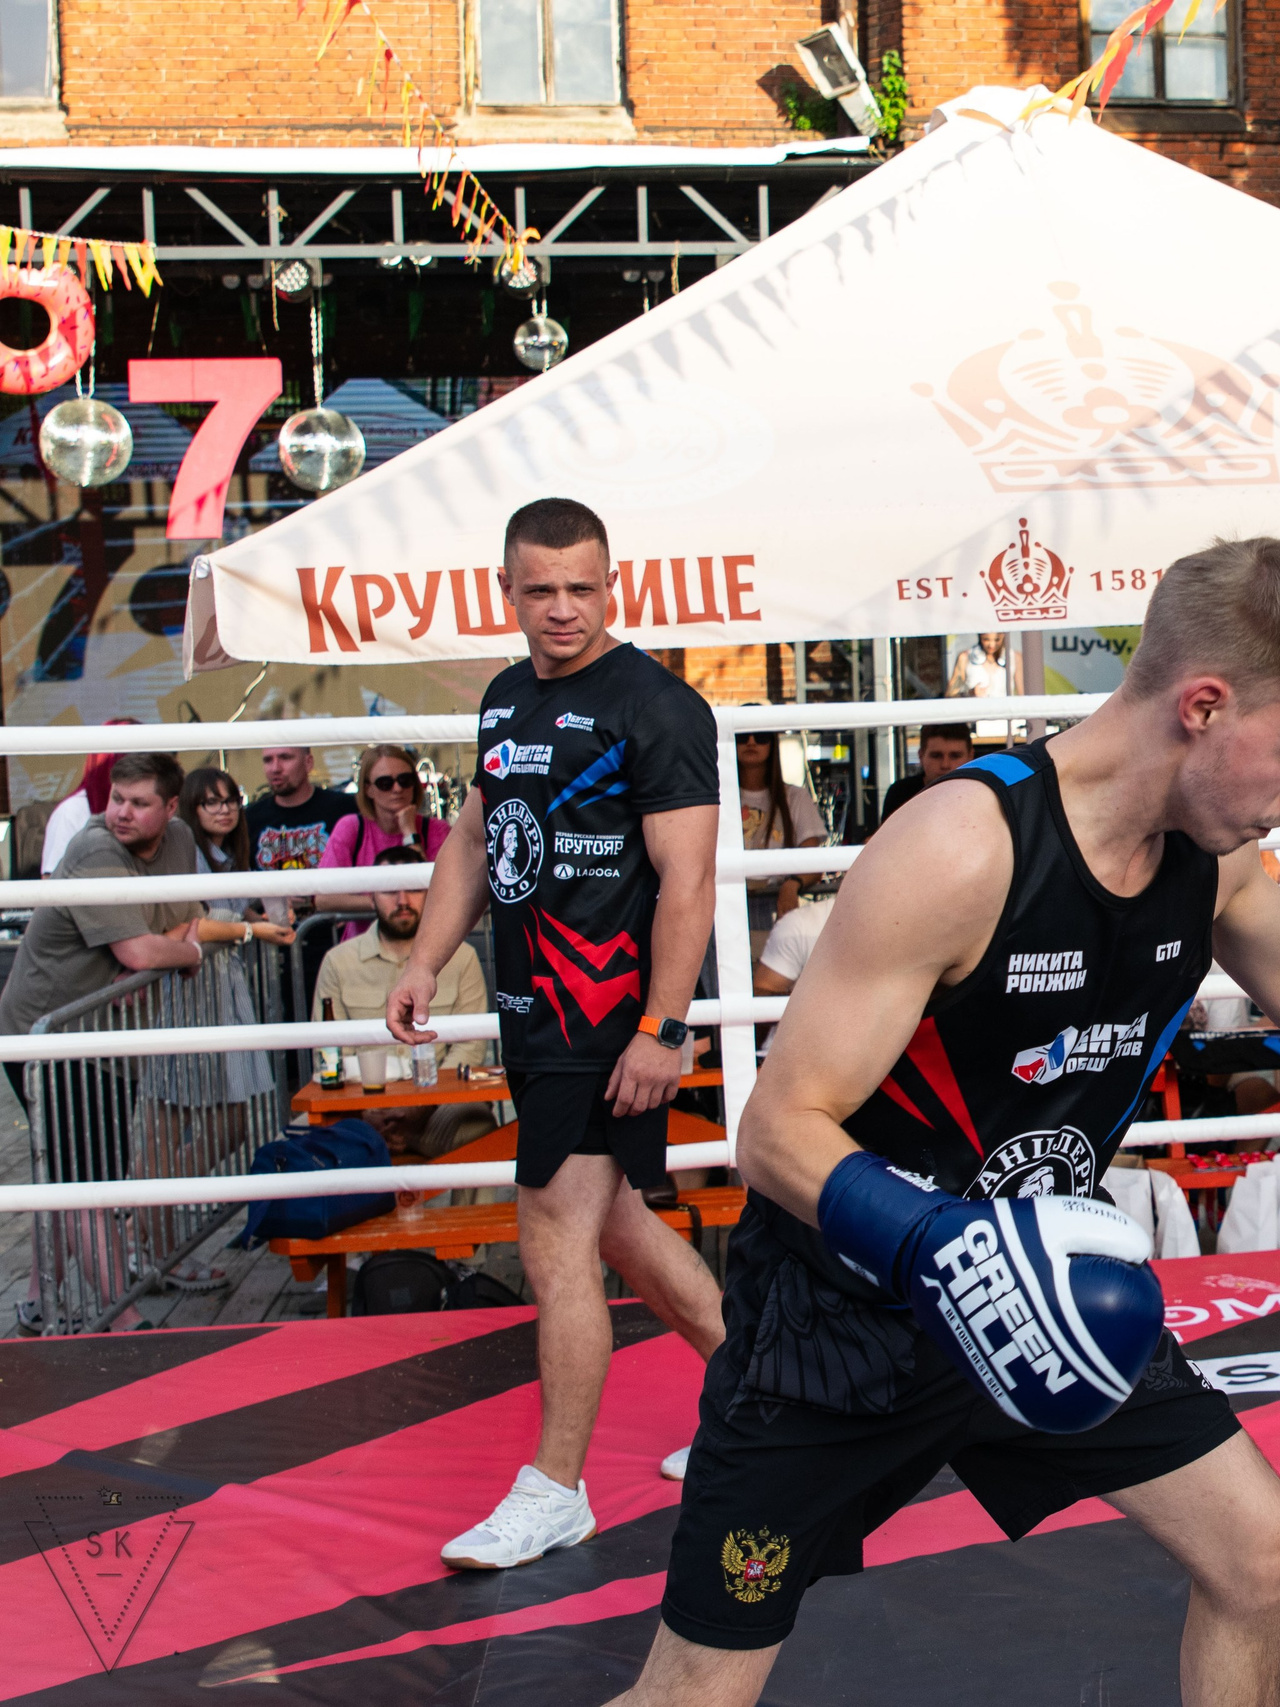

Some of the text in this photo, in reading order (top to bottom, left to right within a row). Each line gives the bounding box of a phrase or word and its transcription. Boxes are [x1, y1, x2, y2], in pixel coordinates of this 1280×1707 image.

[128, 357, 283, 540] 7
[896, 577, 969, 601] EST.
[296, 554, 763, 654] КРУШИЦЕ
[1051, 635, 1133, 656] Шучу,
[554, 837, 624, 856] КРУТОЯР
[576, 867, 620, 878] LADOGA
[493, 878, 531, 898] 2010
[1008, 950, 1084, 973] НИКИТА
[1005, 969, 1088, 994] РОНЖИН
[978, 1132, 1091, 1200] АНЦЛЕРЪ
[933, 1235, 1021, 1391] HILL
[963, 1219, 1079, 1395] GREEN
[954, 1323, 974, 1353] YOUR
[971, 1352, 989, 1377] BEST
[987, 1377, 1005, 1399] SELF
